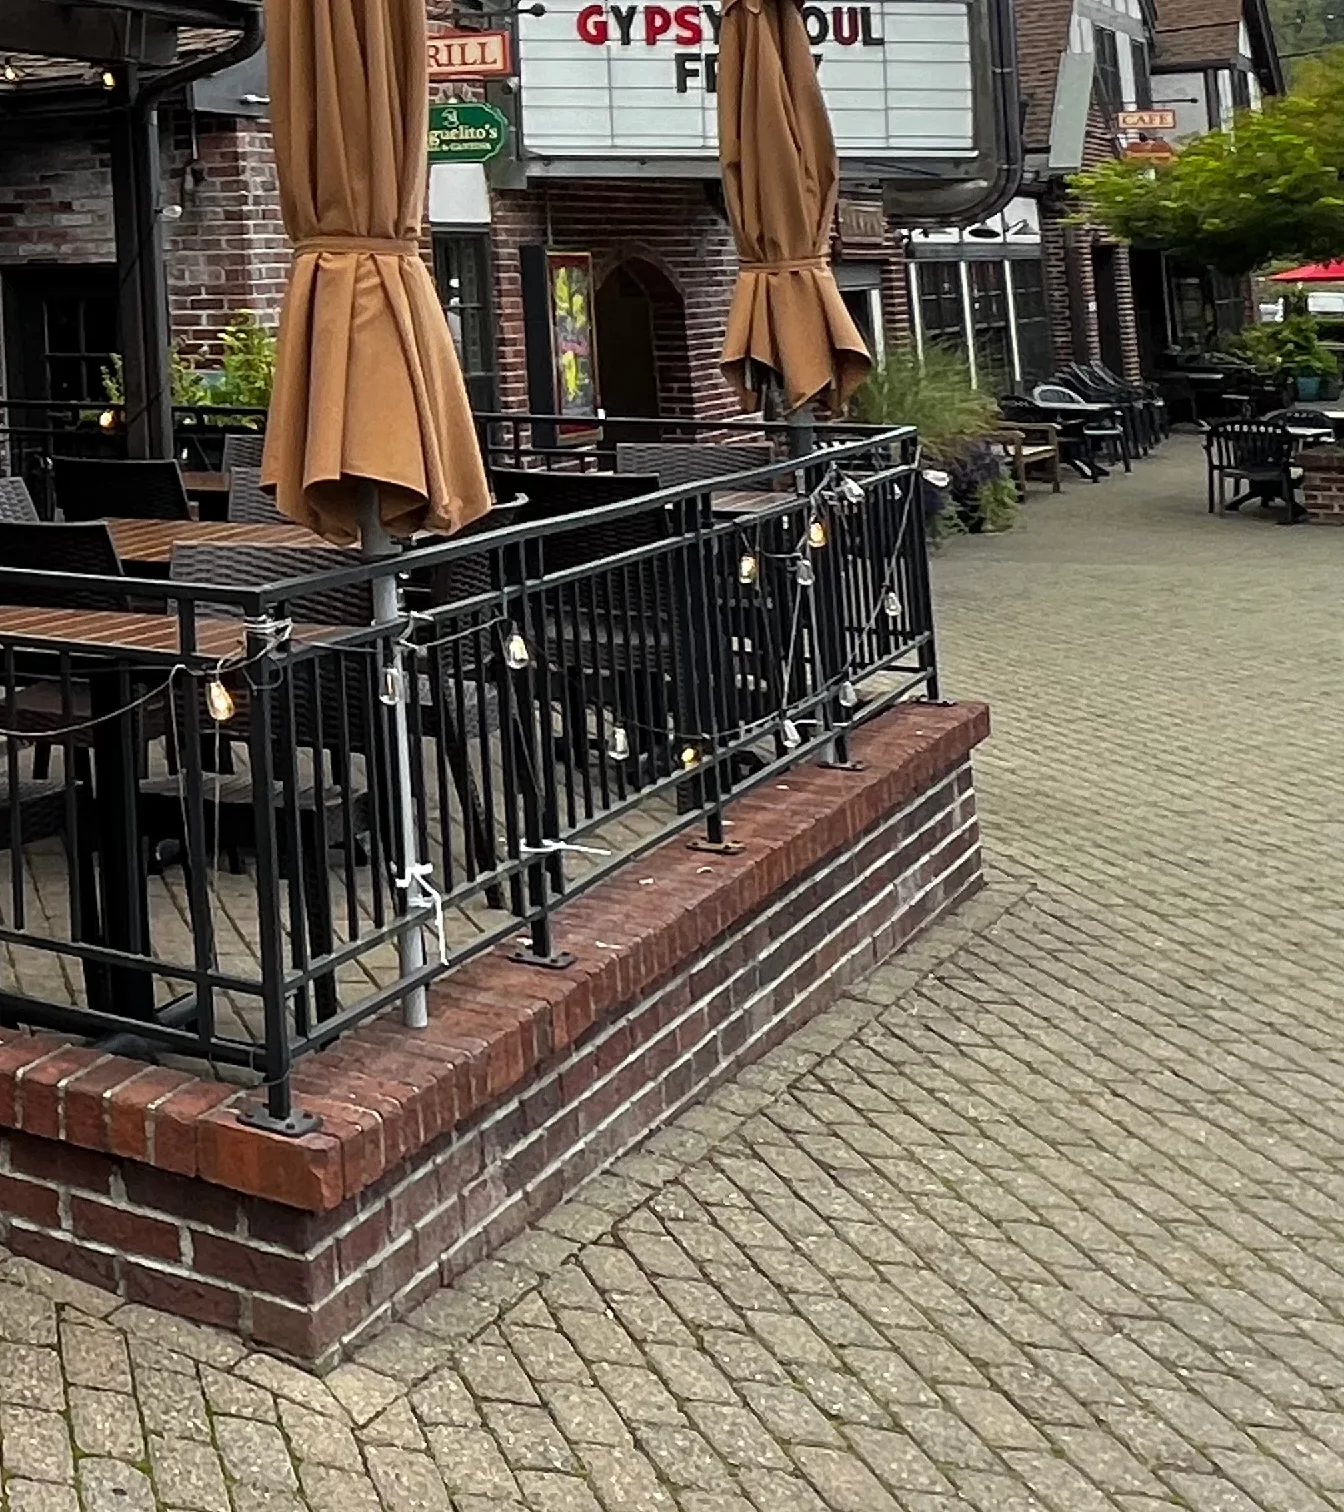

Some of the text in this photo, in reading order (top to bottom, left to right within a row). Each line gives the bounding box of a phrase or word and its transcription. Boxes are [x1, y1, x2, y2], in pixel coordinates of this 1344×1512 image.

[576, 4, 885, 46] GYPSY OUL
[426, 42, 498, 68] RILL
[428, 124, 498, 147] guelito's
